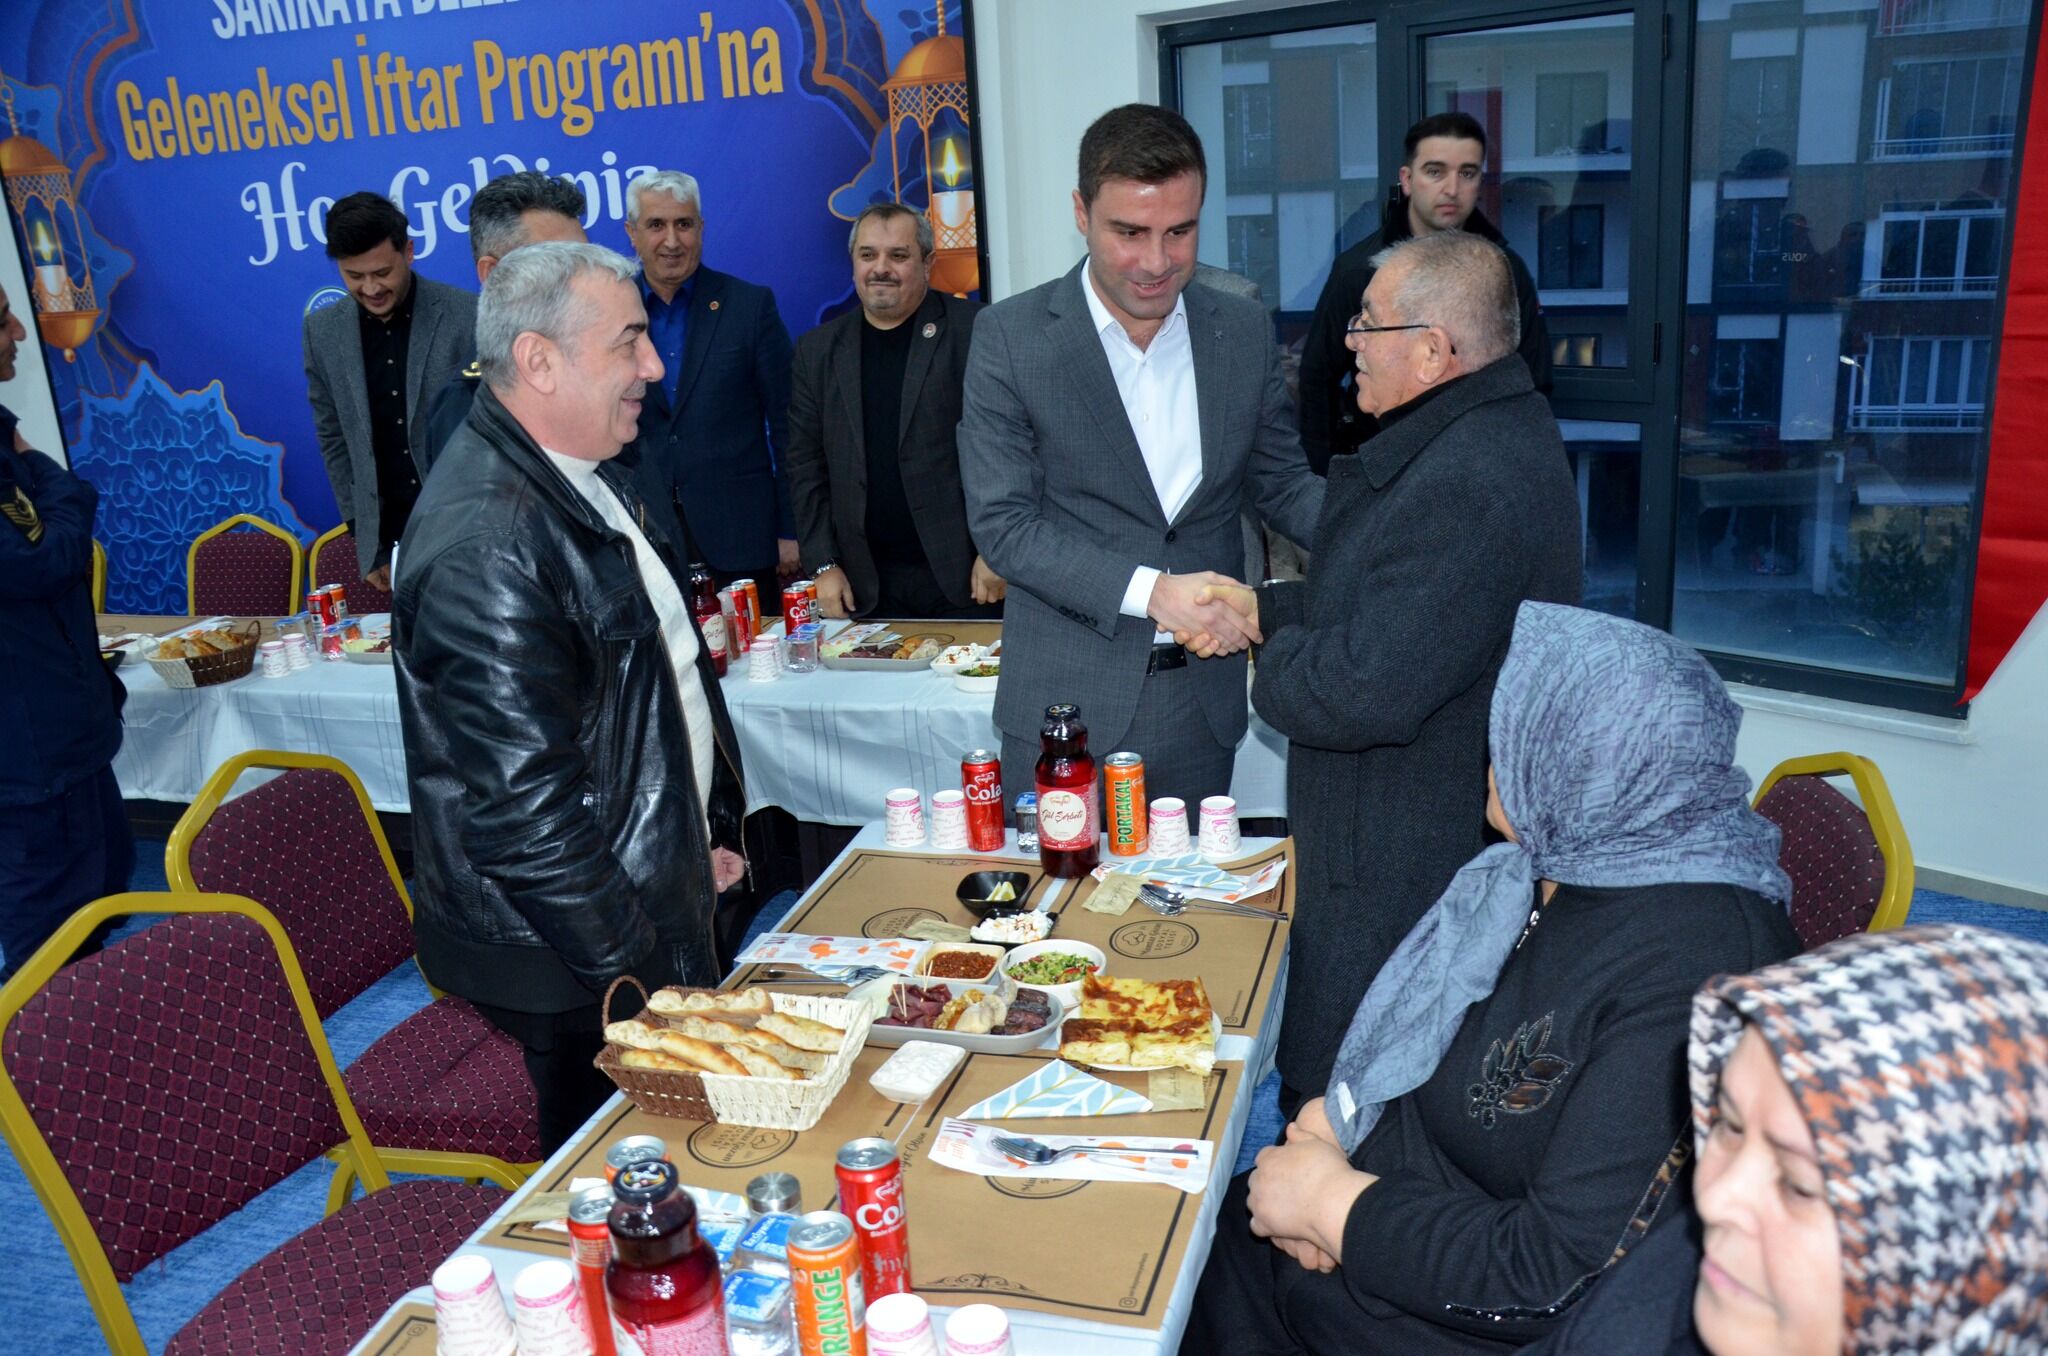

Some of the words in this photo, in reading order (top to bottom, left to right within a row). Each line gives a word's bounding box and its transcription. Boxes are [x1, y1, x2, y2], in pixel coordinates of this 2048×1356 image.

[116, 58, 354, 161] Geleneksel
[355, 34, 463, 137] İftar
[473, 11, 784, 137] Programı'na
[965, 783, 1002, 801] Cola
[1114, 778, 1134, 845] PORTAKAL
[856, 1192, 905, 1231] Col
[811, 1266, 853, 1356] RANGE
